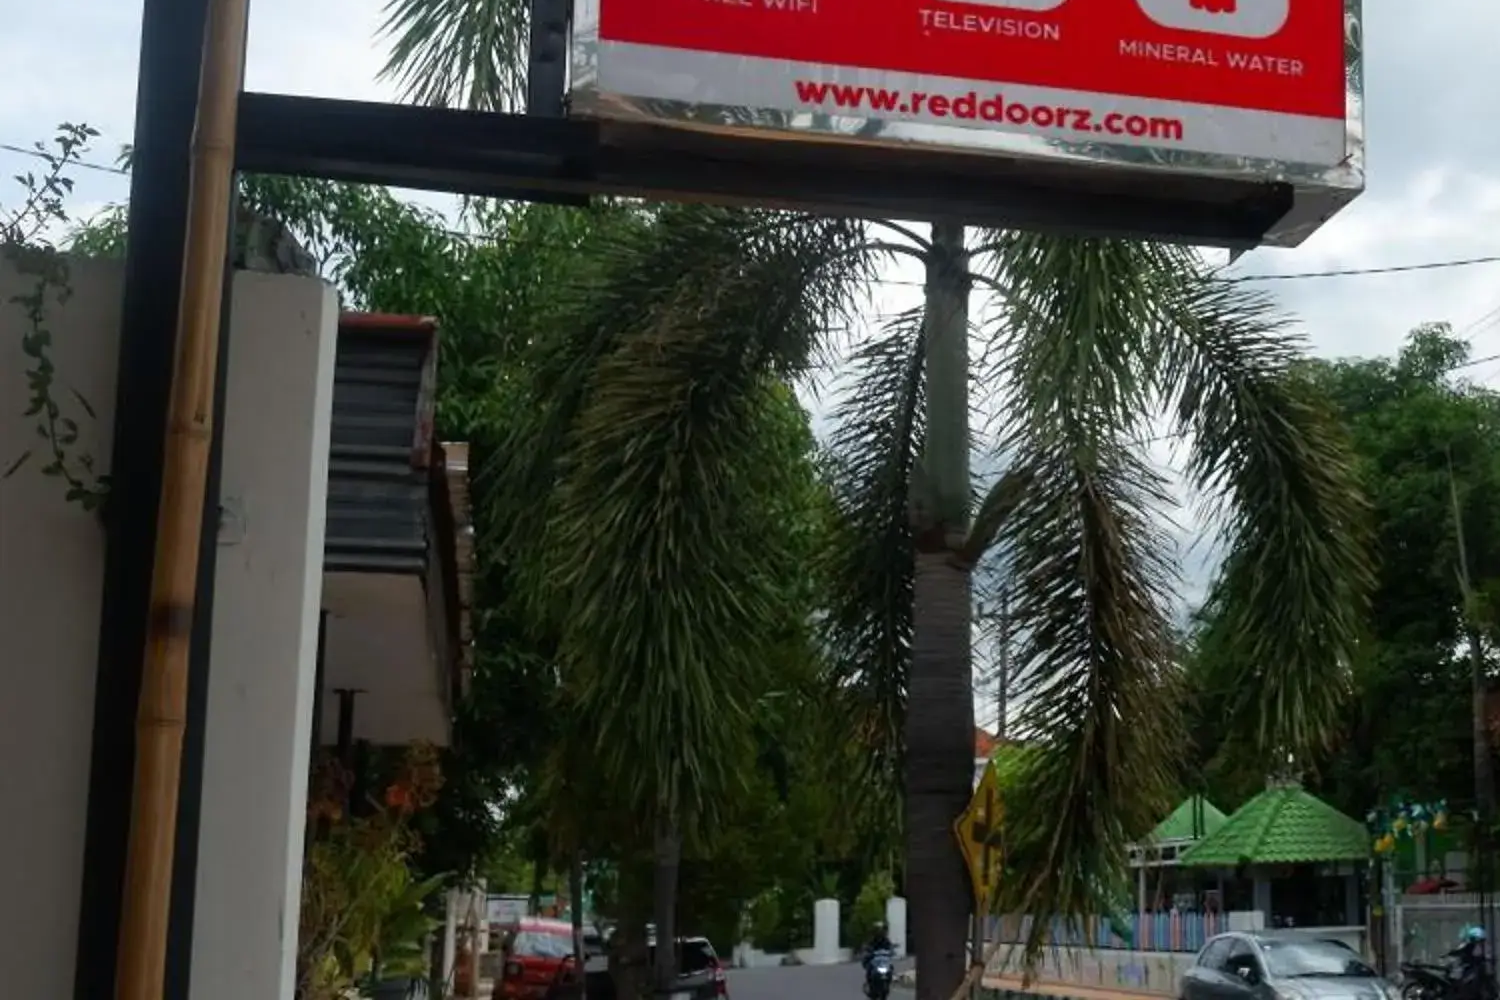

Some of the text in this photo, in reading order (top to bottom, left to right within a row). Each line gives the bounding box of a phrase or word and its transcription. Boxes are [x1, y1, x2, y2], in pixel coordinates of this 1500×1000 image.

[921, 9, 1060, 39] TELEVISION
[1119, 39, 1303, 76] MINERAL WATER
[796, 79, 1183, 140] www.reddoorz.com
